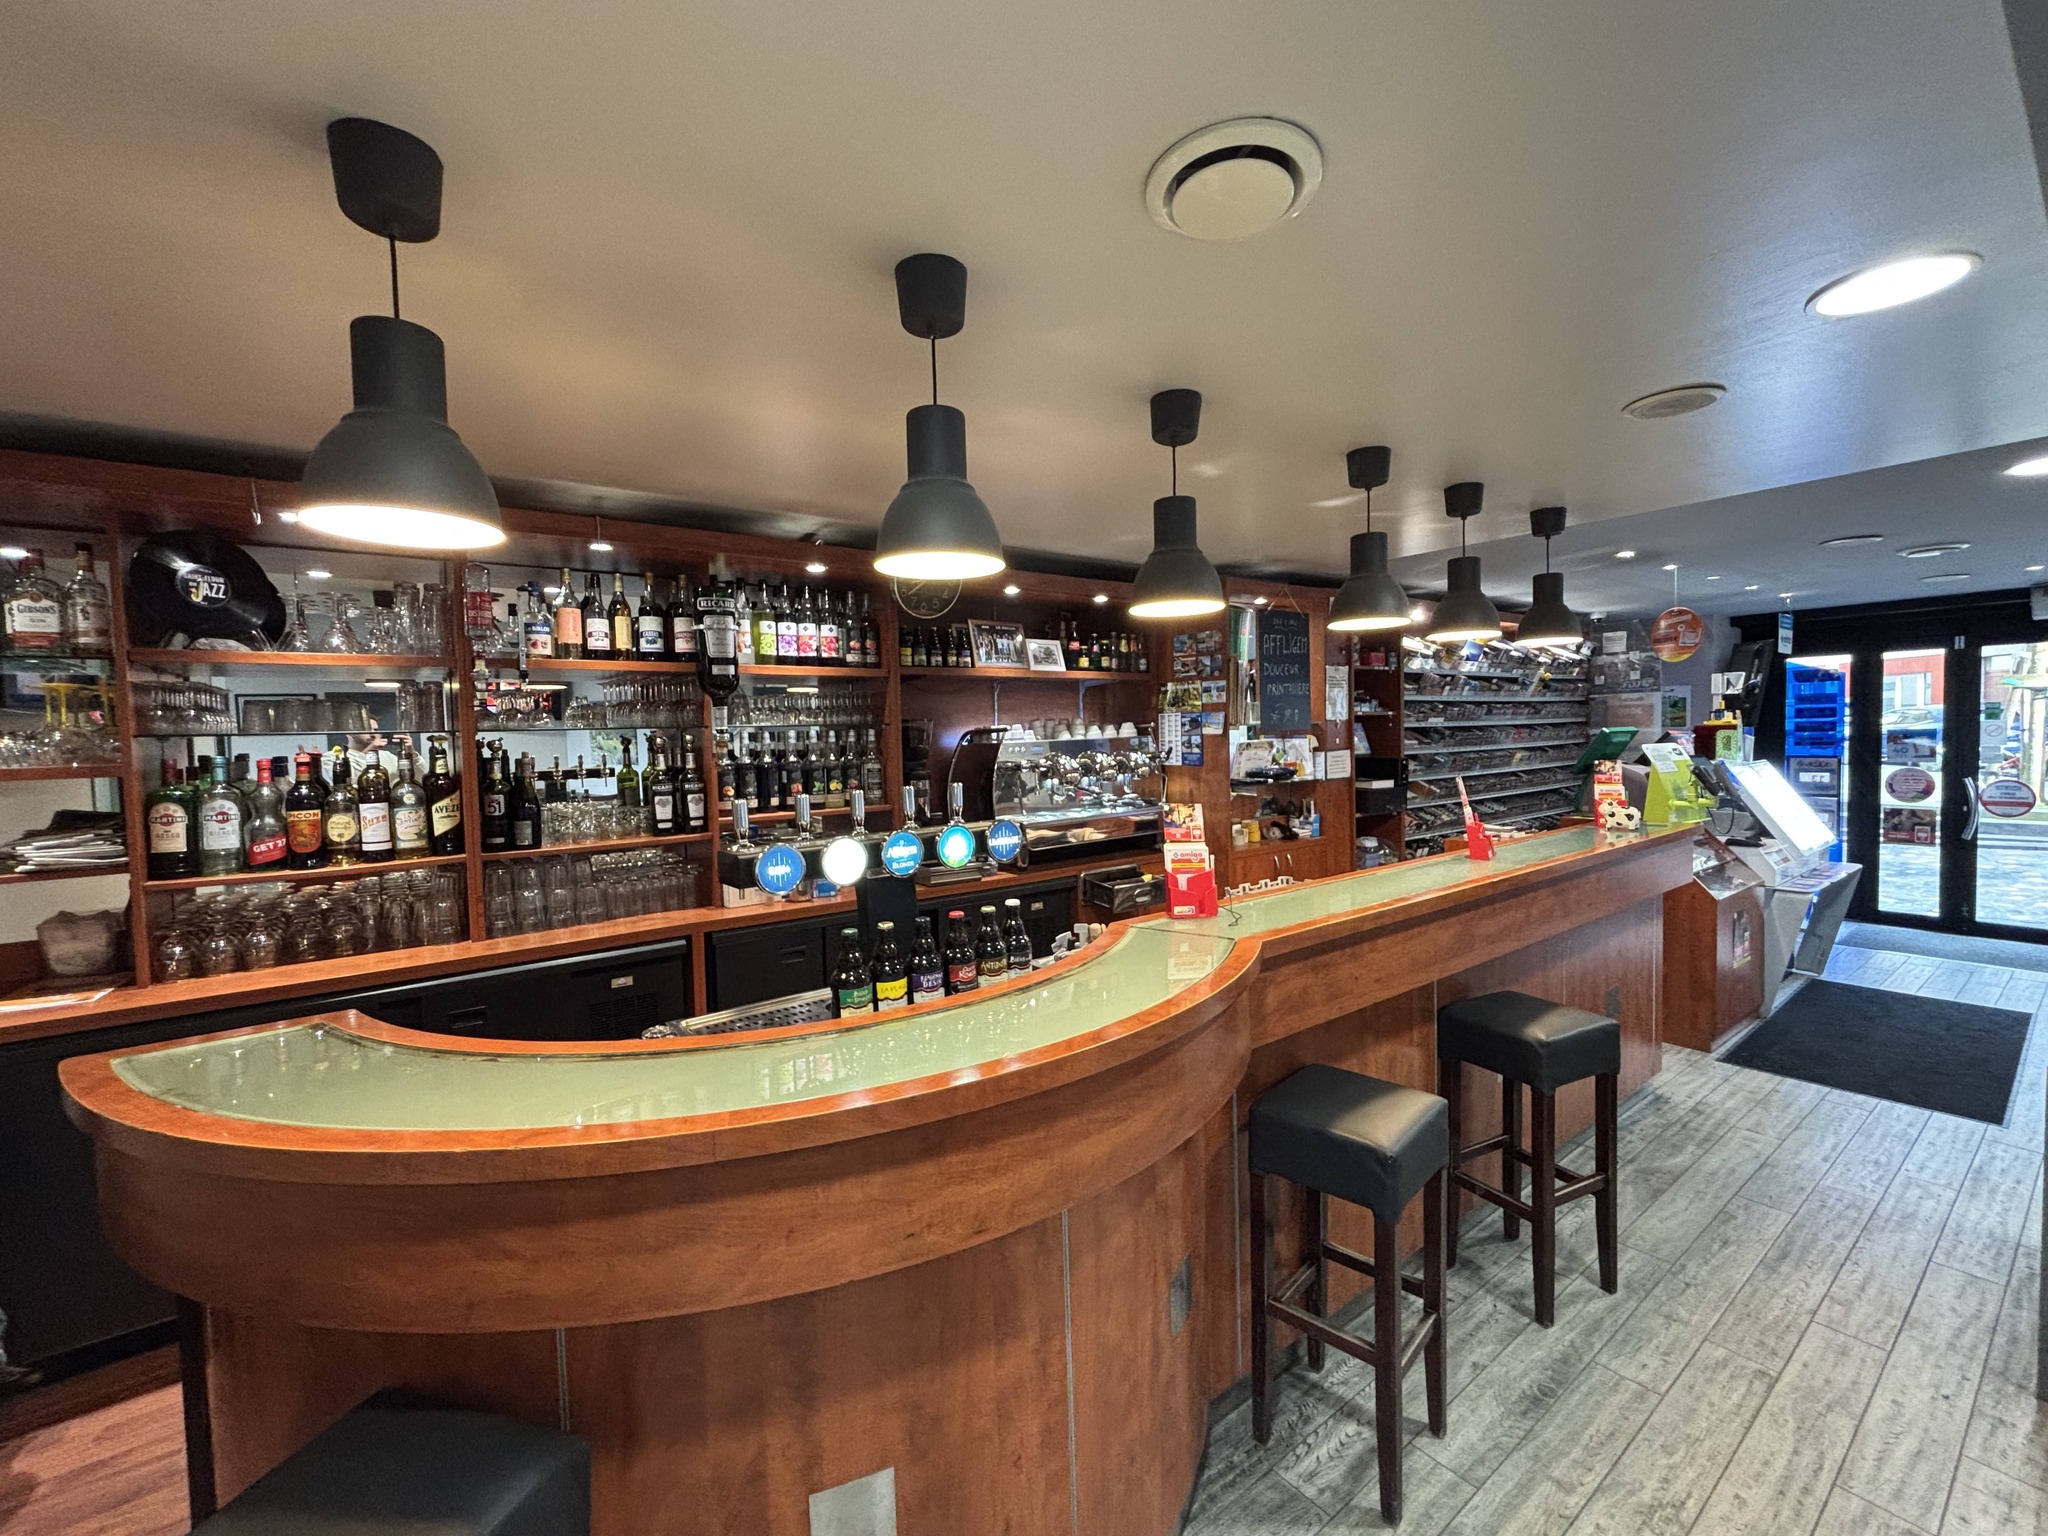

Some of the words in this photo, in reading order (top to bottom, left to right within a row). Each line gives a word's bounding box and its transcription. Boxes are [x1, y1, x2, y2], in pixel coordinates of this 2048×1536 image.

[189, 579, 226, 602] JAZZ
[700, 600, 735, 608] RICARD
[1263, 633, 1308, 656] AFFLIGEM
[487, 801, 502, 815] 51
[205, 813, 239, 821] MARTINI
[287, 811, 320, 820] PICON
[362, 814, 388, 828] Suze
[253, 843, 275, 853] GET
[276, 837, 287, 848] 27
[1180, 851, 1202, 860] amigo
